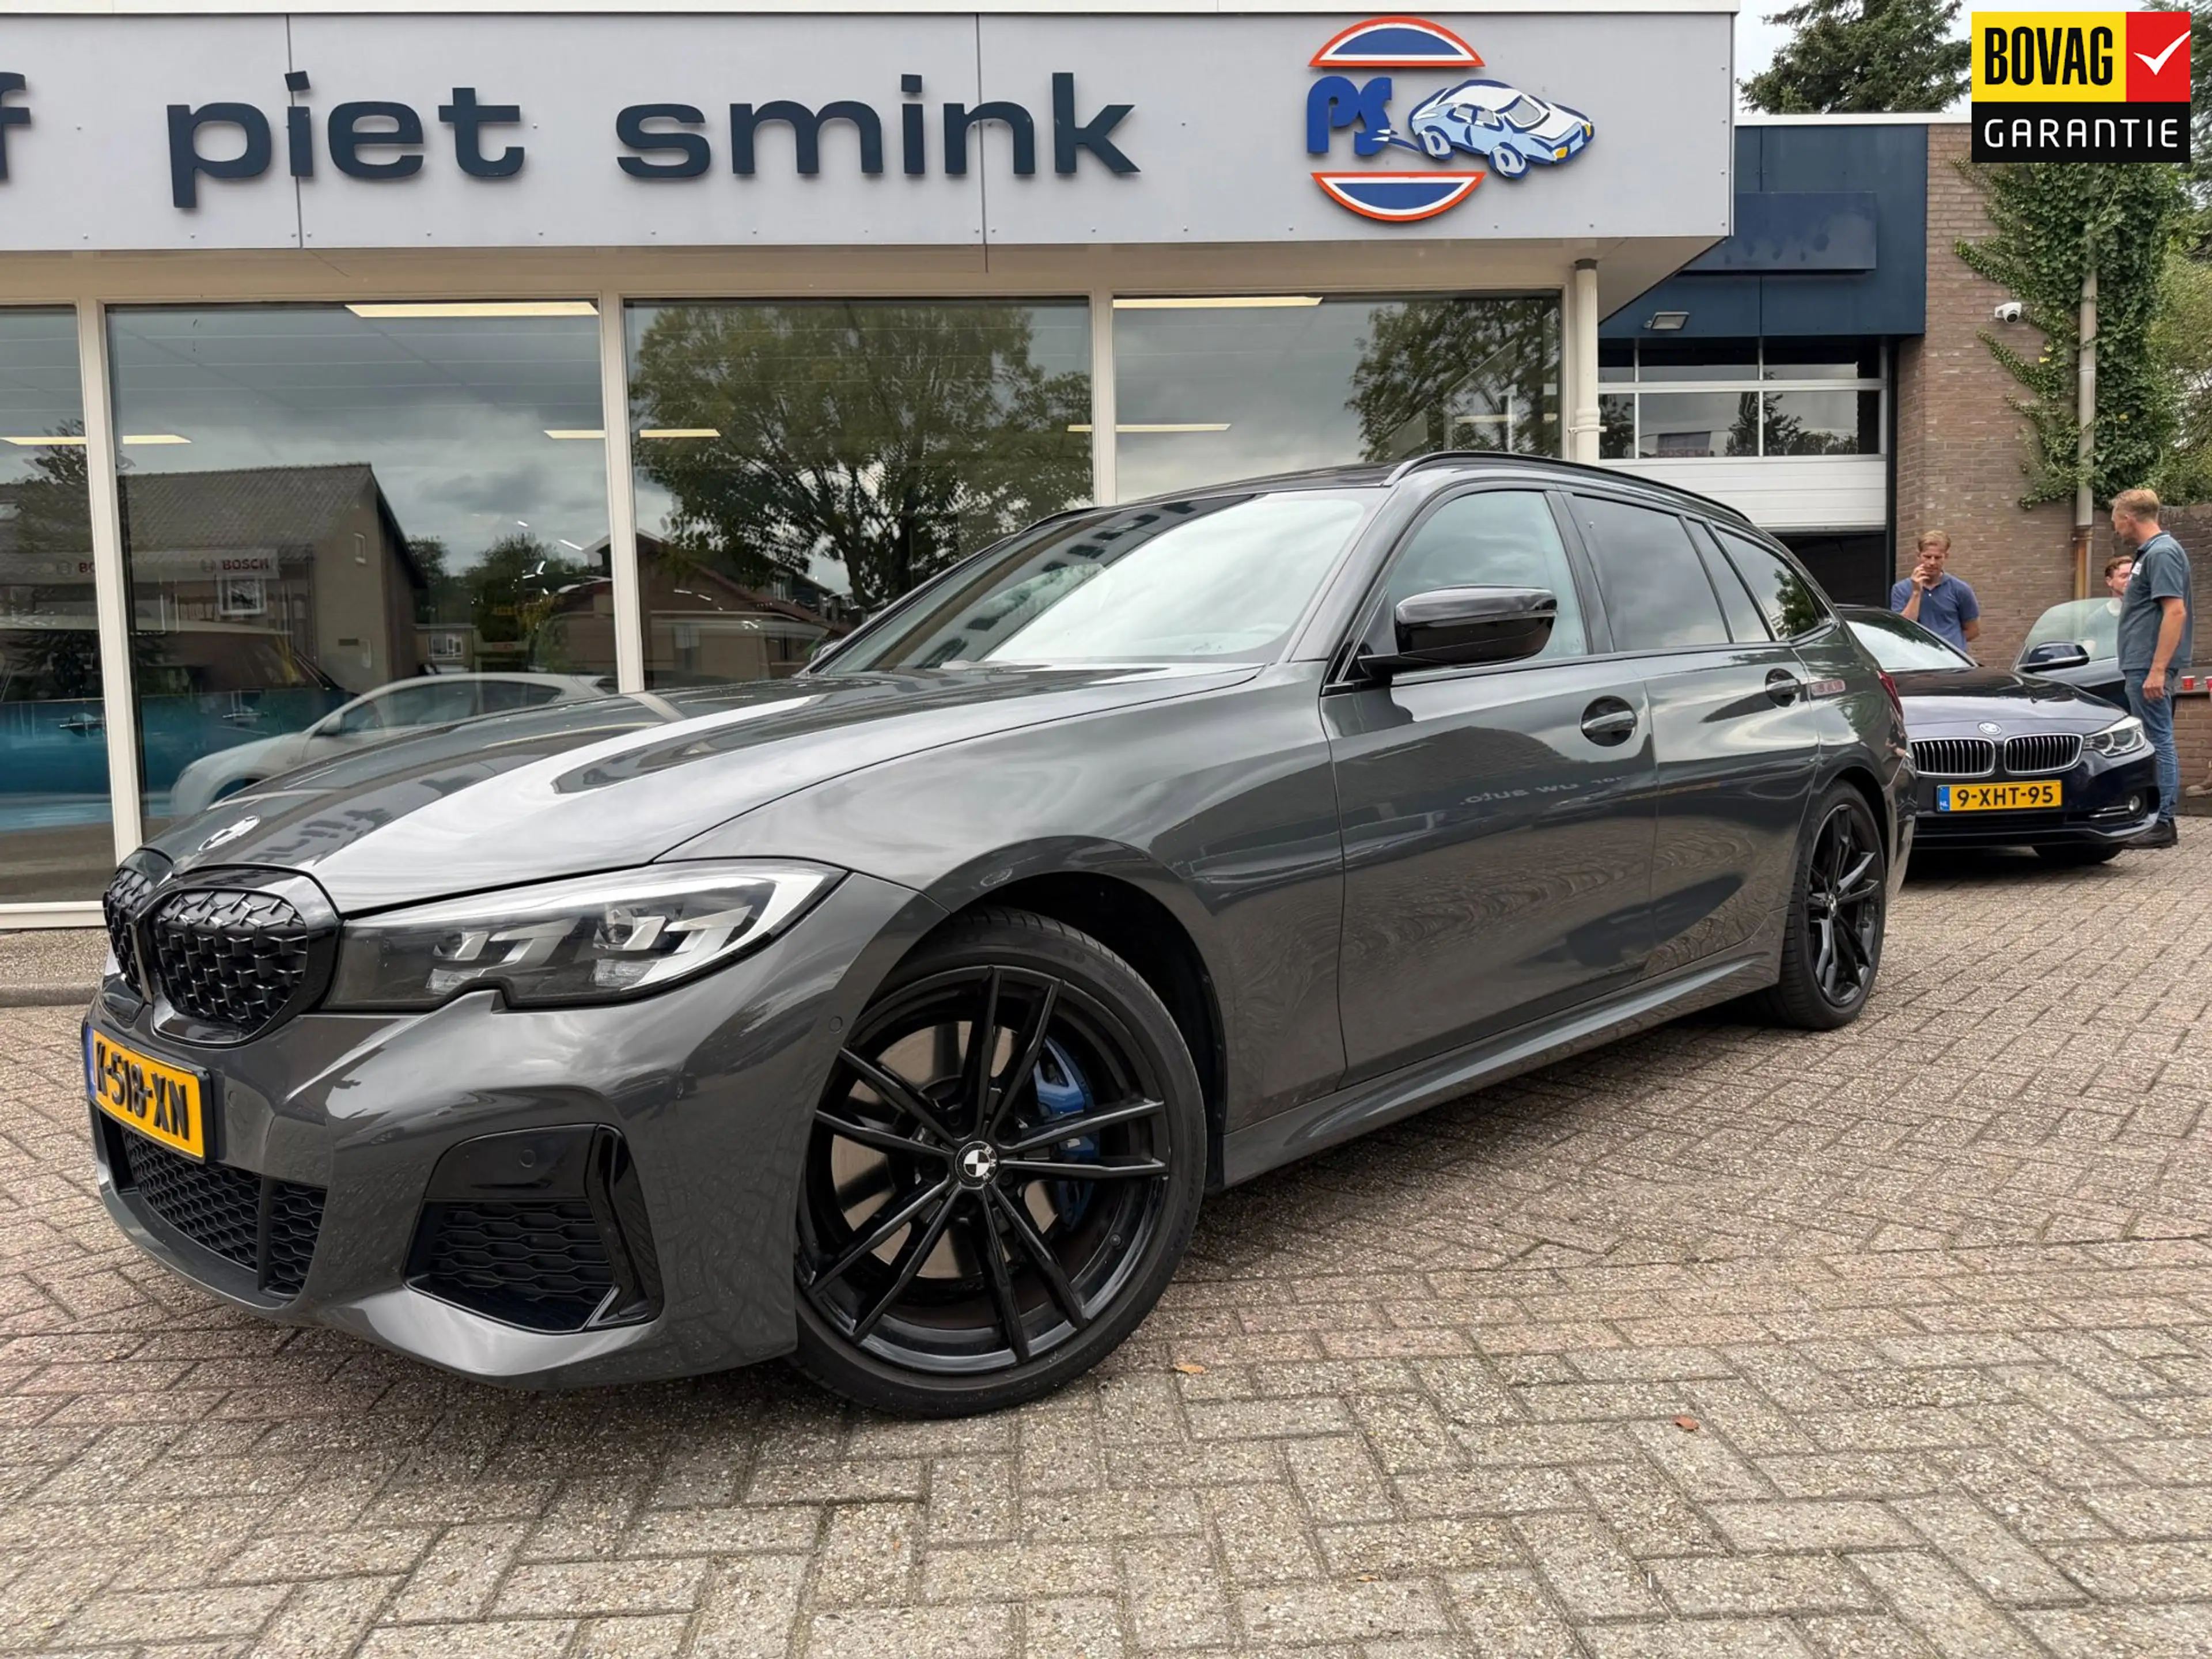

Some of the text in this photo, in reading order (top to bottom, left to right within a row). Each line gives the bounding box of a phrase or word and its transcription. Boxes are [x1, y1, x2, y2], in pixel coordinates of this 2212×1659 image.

[166, 70, 525, 209] piet
[616, 72, 1141, 178] smink
[222, 558, 270, 570] BOSCH
[1957, 786, 2054, 807] 9-XHT-95
